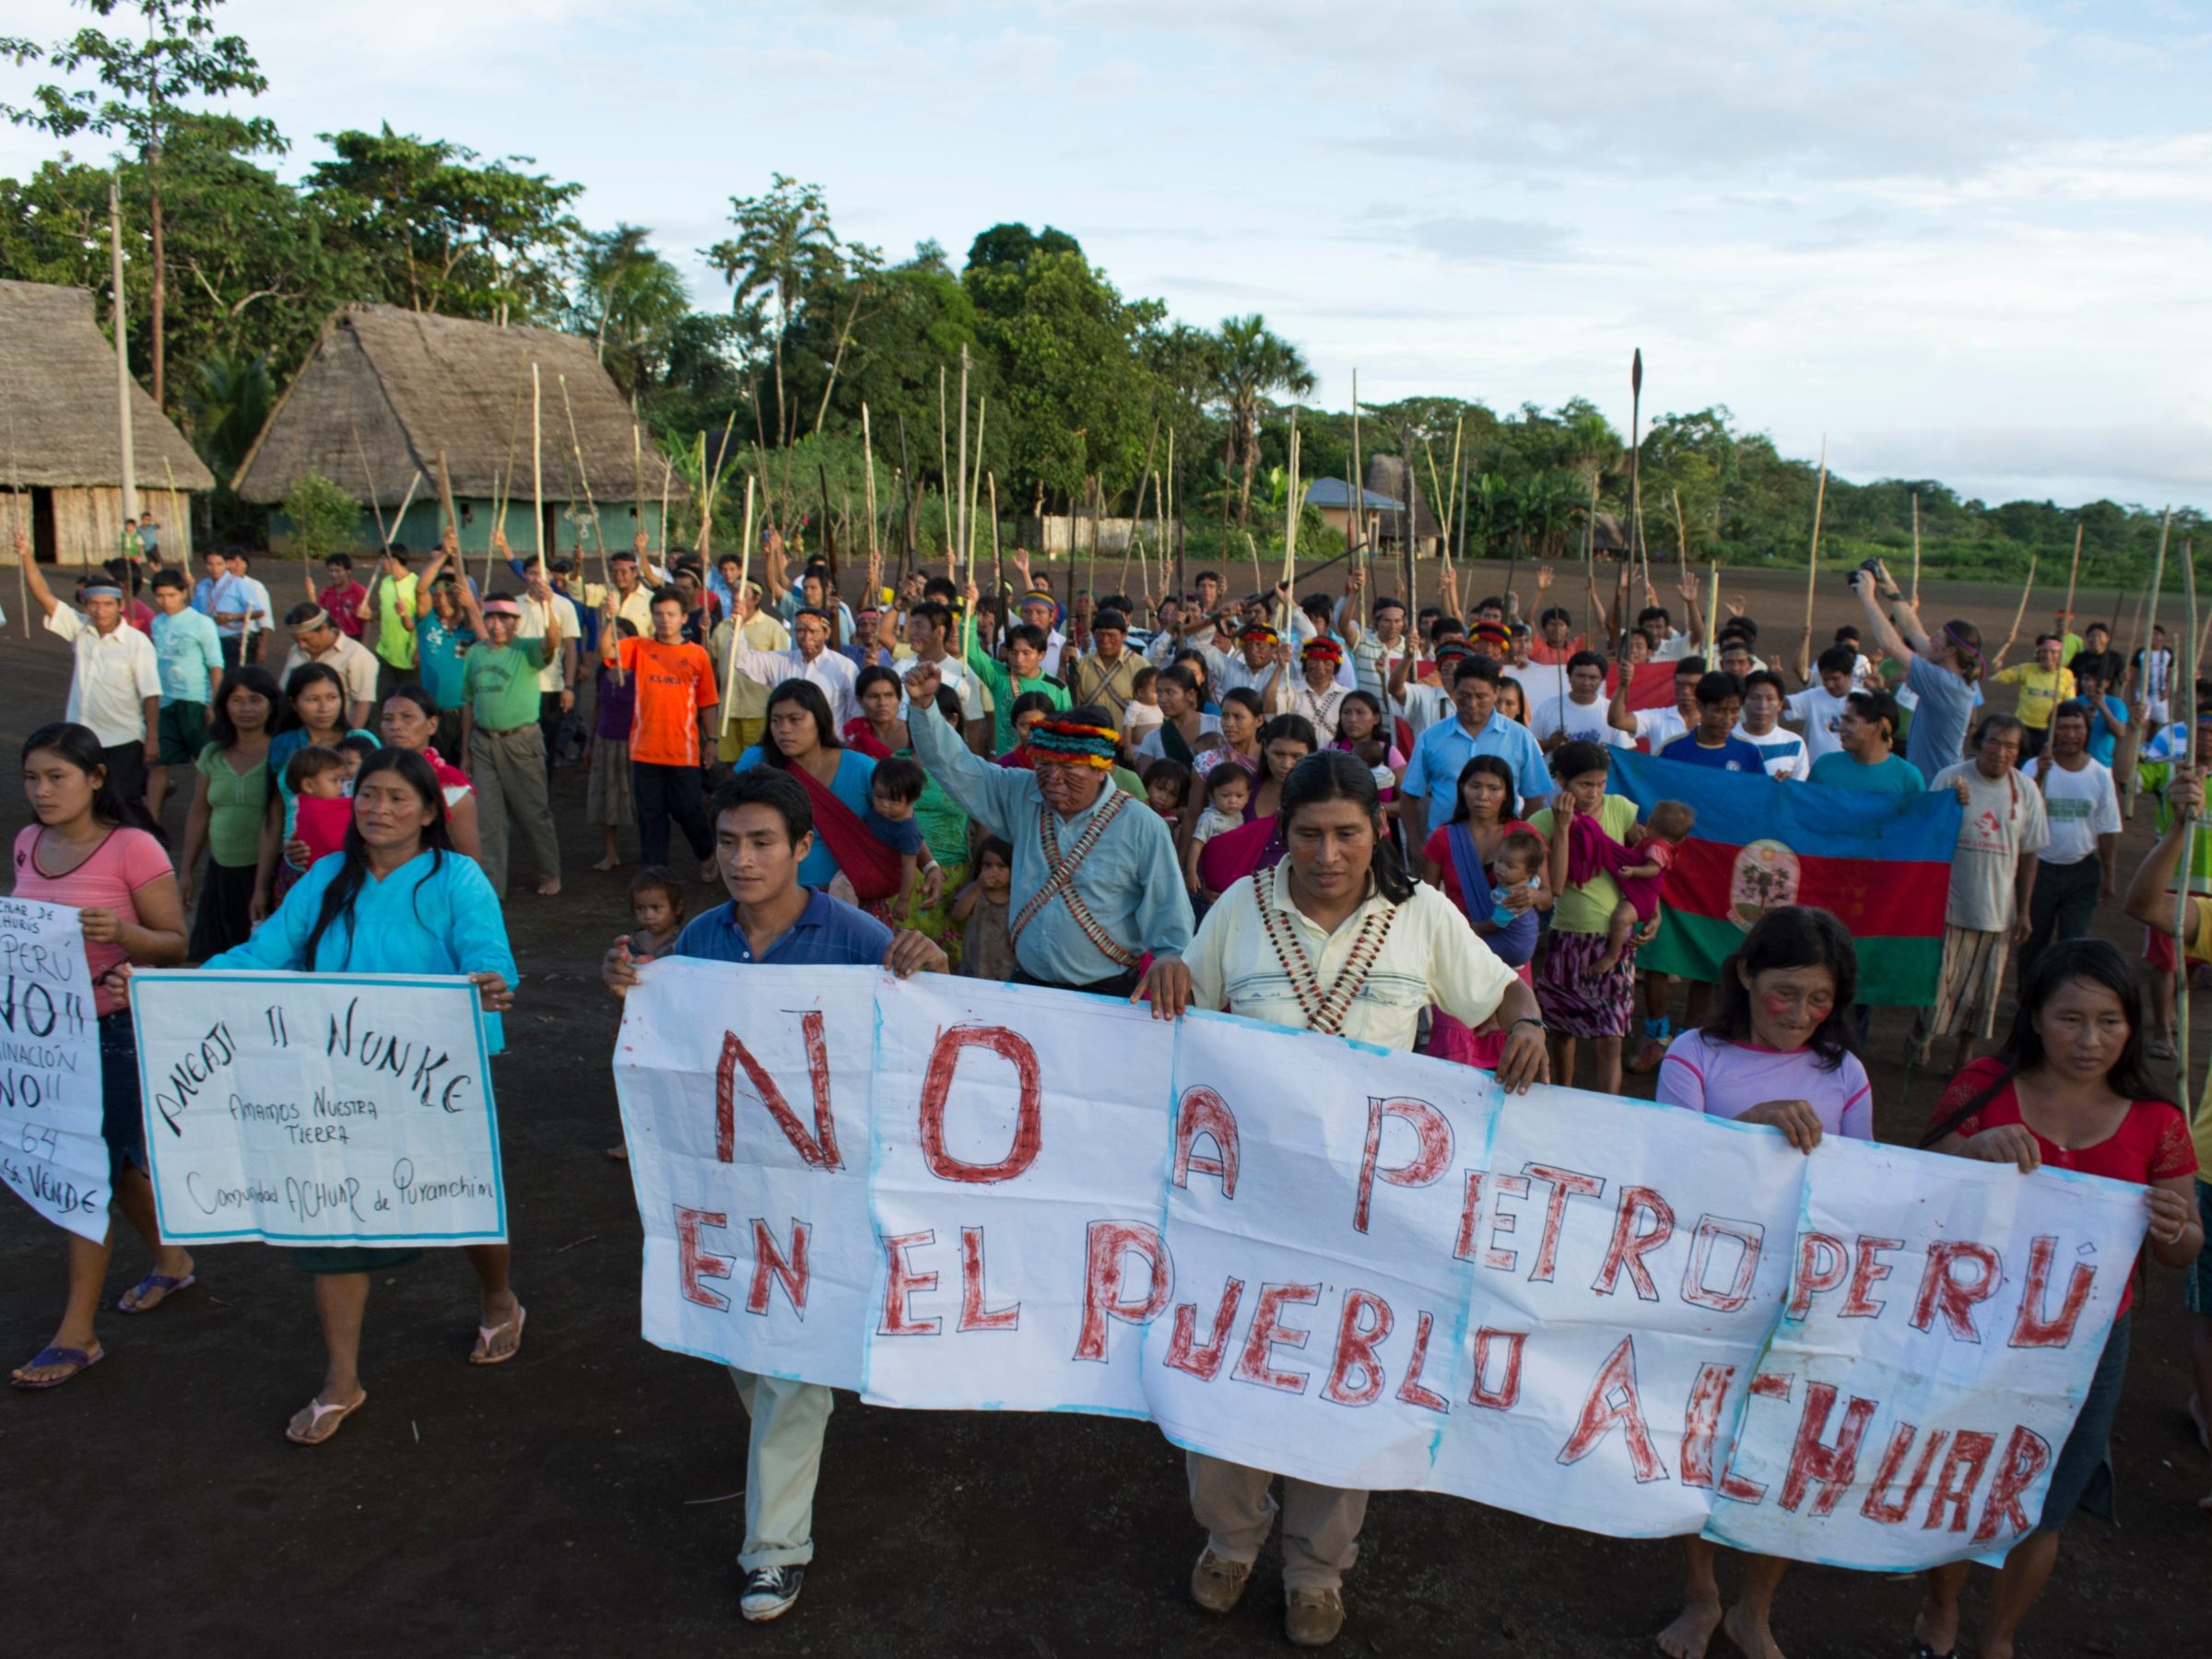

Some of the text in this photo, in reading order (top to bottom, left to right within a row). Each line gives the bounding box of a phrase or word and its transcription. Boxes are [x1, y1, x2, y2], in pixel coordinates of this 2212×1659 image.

[0, 1041, 77, 1072] INACIÓN
[715, 1009, 1042, 1183] NO
[1172, 1084, 1241, 1200] A
[284, 1124, 351, 1145] TIERRA
[374, 1190, 391, 1211] de
[674, 1204, 2053, 1545] EN EL PUEBLO ACHUAR
